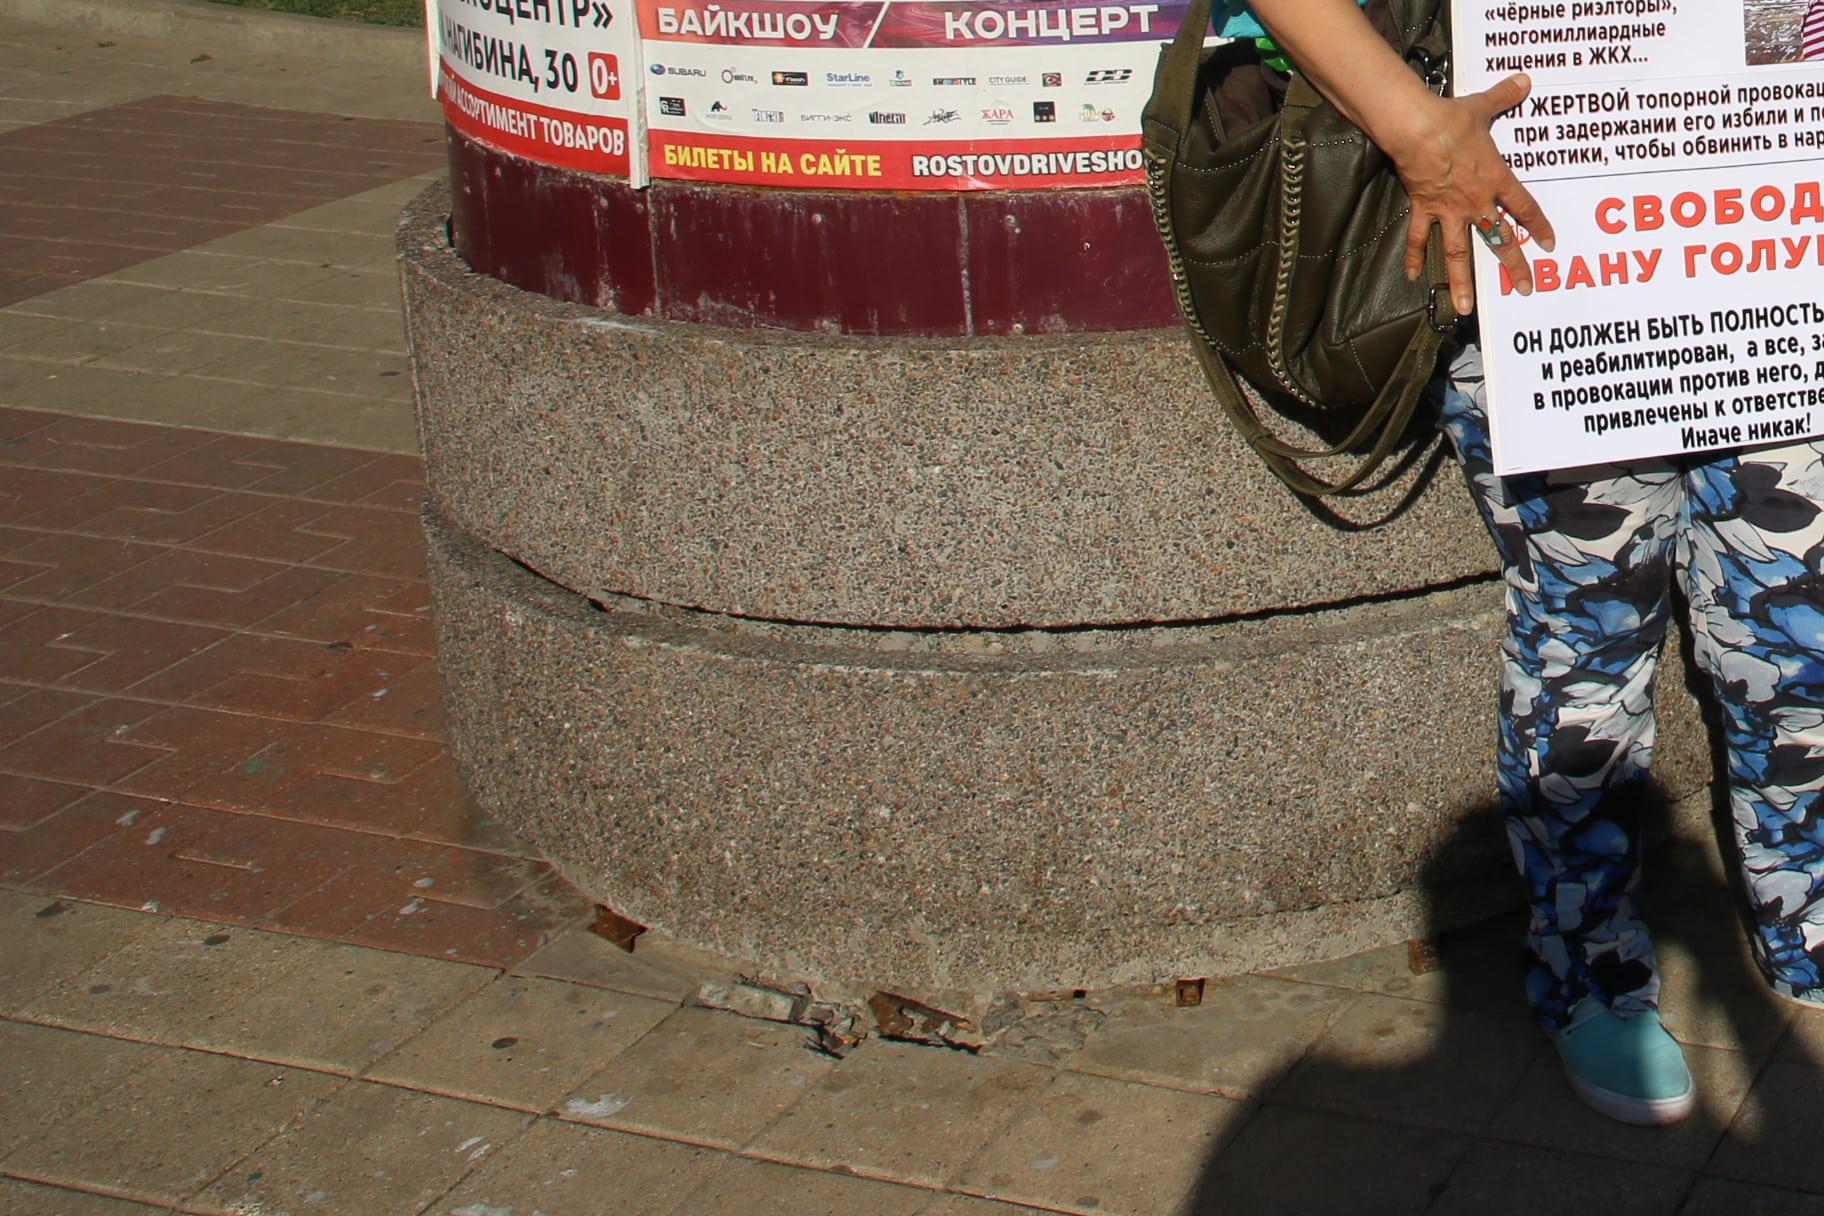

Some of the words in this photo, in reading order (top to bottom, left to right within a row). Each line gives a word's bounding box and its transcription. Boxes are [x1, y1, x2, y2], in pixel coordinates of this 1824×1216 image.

[658, 4, 838, 41] БАЙКШОУ
[944, 4, 1158, 41] КОНЦЕРТ
[1485, 2, 1565, 24] «чёрные
[1572, 0, 1676, 20] риэлторы»,
[1486, 23, 1665, 47] многомиллиардные
[544, 49, 579, 93] 30
[592, 58, 618, 94] 0+
[668, 66, 706, 78] SUBARU
[1486, 53, 1566, 72] хищения
[1573, 52, 1582, 66] в
[1589, 45, 1647, 64] ЖКХ...
[827, 72, 870, 82] StarLine
[989, 76, 1003, 84] CITY
[1005, 76, 1027, 84] GUIDE
[1530, 88, 1629, 117] ЖЕРТВОЙ
[1636, 85, 1730, 110] топорной
[456, 90, 538, 140] АССОРТИМЕНТ
[540, 117, 625, 156] ТОВАРОВ
[1515, 126, 1548, 146] при
[1556, 117, 1676, 141] задержании
[1684, 115, 1715, 131] его
[1723, 107, 1787, 128] избили
[1795, 108, 1803, 122] и
[664, 143, 754, 171] БИЛЕТЫ
[760, 152, 794, 175] НА
[800, 149, 882, 177] САЙТЕ
[911, 149, 1144, 177] ROSTOVDRIVESHO
[1502, 145, 1609, 171] наркотики,
[1615, 138, 1675, 160] чтобы
[1683, 135, 1772, 156] обвинить
[1779, 134, 1788, 148] в
[1513, 330, 1542, 354] ОН
[1550, 320, 1640, 354] ДОЛЖЕН
[1647, 314, 1704, 340] БЫТЬ
[1542, 363, 1553, 380] и
[1560, 344, 1734, 382] реабилитирован,
[1748, 341, 1758, 357] а
[1765, 337, 1804, 356] все,
[1534, 393, 1545, 410] в
[1552, 378, 1673, 411] провокации
[1680, 369, 1749, 395] против
[1757, 364, 1808, 384] него,
[1584, 402, 1708, 435] привлечены
[1715, 400, 1726, 416] к
[1682, 426, 1741, 449] Иначе
[1748, 412, 1810, 440] никак!
